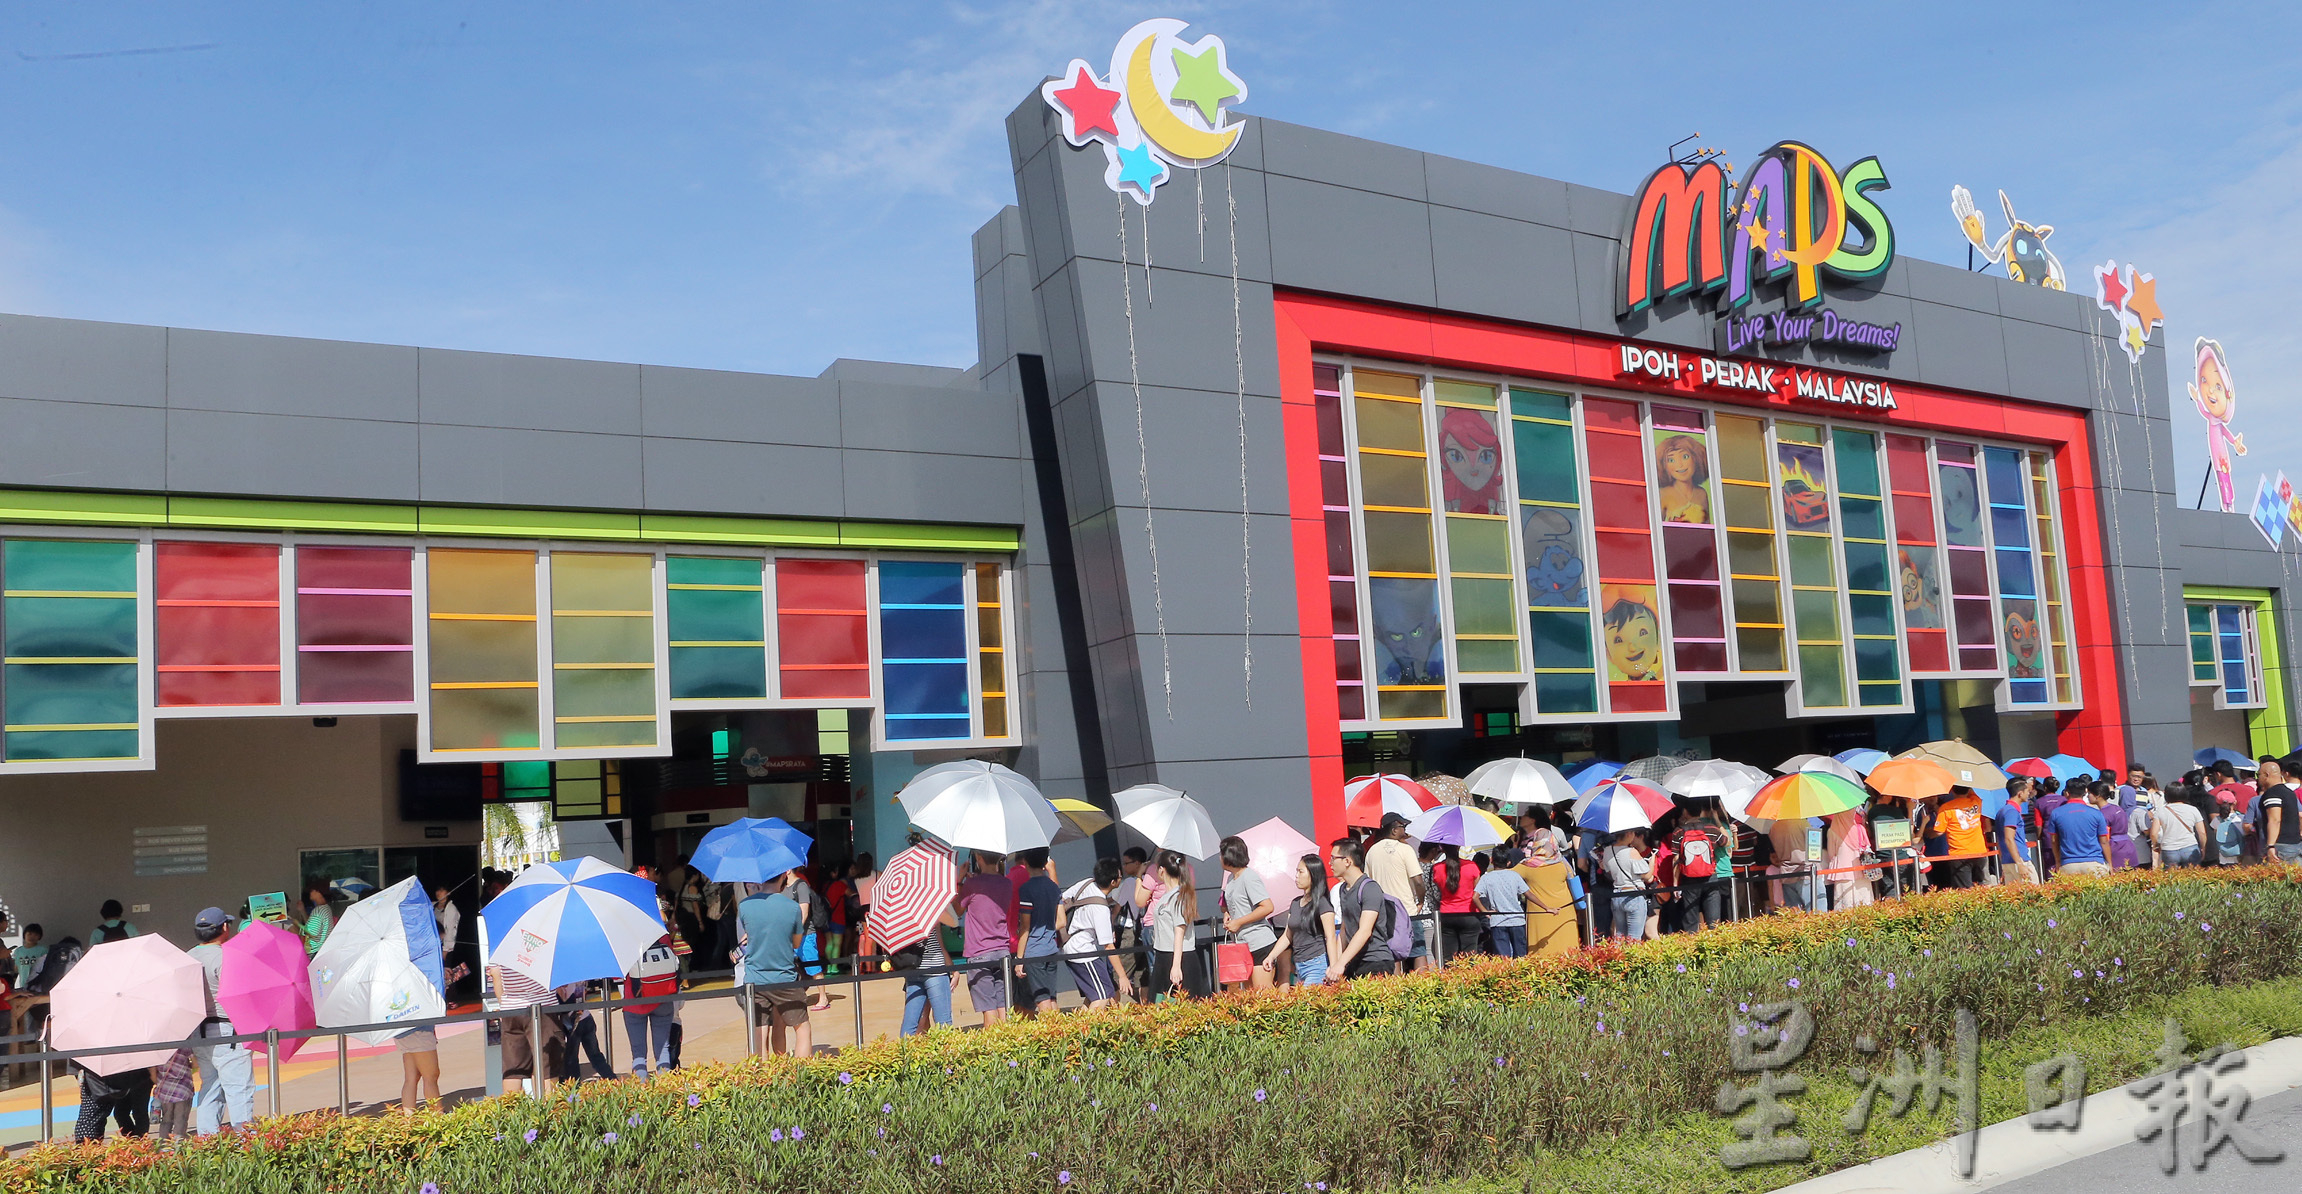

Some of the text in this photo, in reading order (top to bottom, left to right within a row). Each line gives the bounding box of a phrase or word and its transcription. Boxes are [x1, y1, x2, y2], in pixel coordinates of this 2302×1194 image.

[1621, 140, 1895, 313] MAPS
[1726, 309, 1901, 352] Live Your Dreams!
[1620, 345, 1898, 410] IPOH PERAK MALAYSIA
[522, 931, 543, 947] EURO
[393, 1004, 420, 1020] DAIKIN
